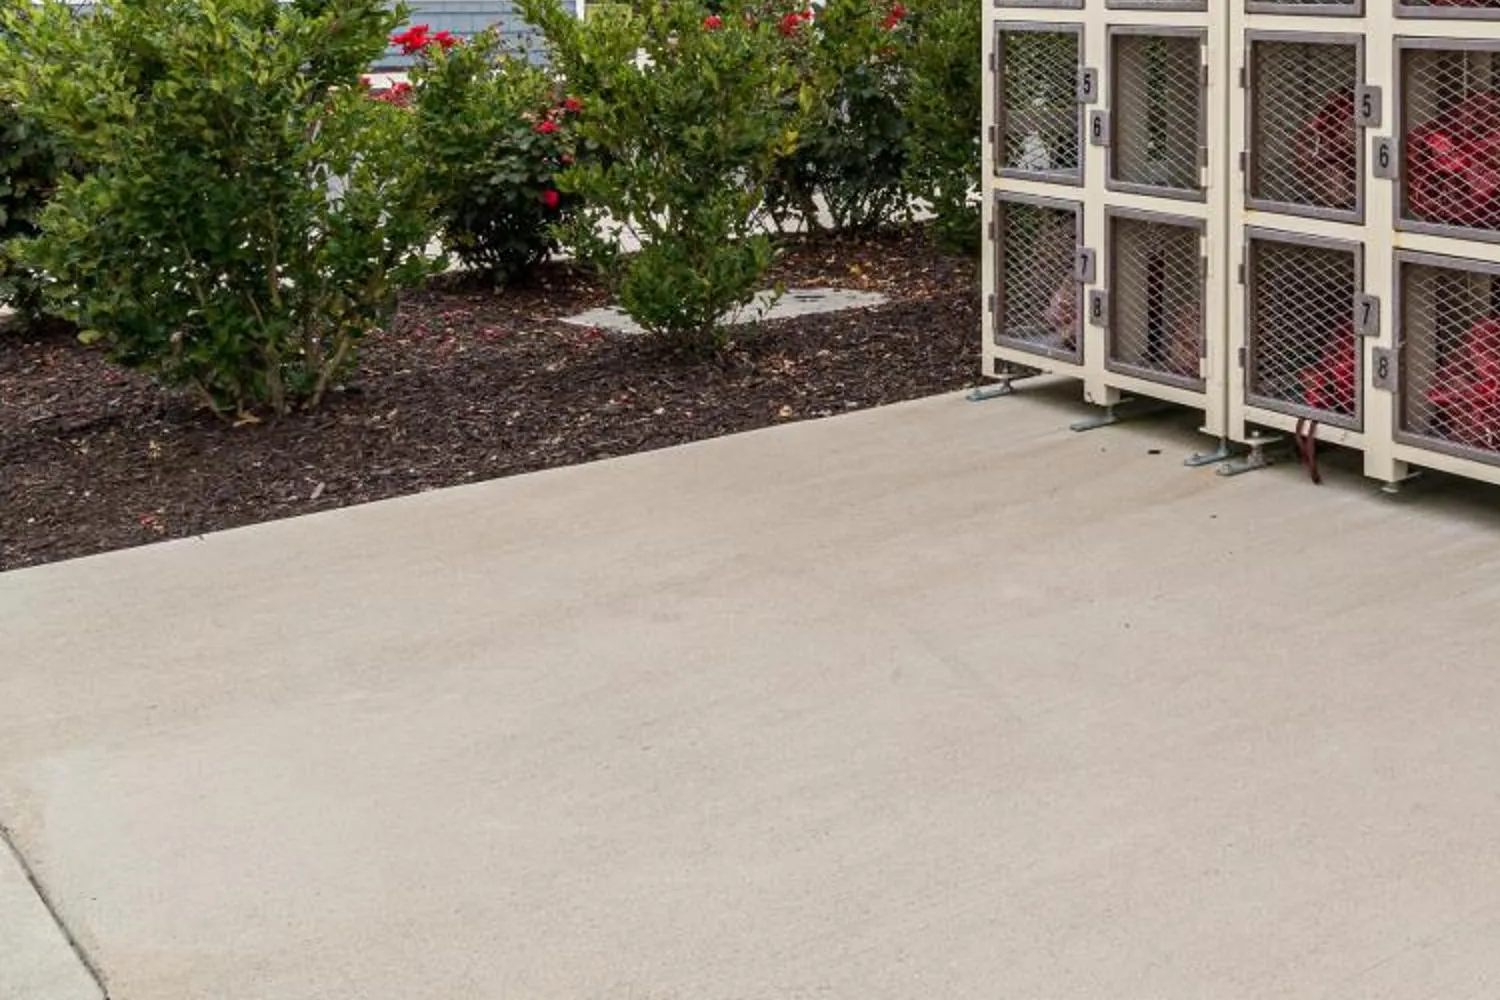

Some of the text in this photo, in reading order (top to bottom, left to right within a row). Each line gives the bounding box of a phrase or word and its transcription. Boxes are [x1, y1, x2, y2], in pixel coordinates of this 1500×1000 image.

[1084, 73, 1090, 94] 5
[1362, 94, 1371, 117] 5
[1094, 117, 1101, 136] 6
[1380, 144, 1388, 168] 6
[1081, 254, 1088, 276] 7
[1094, 298, 1101, 317] 8
[1362, 302, 1370, 324] 7
[1378, 356, 1388, 379] 8
